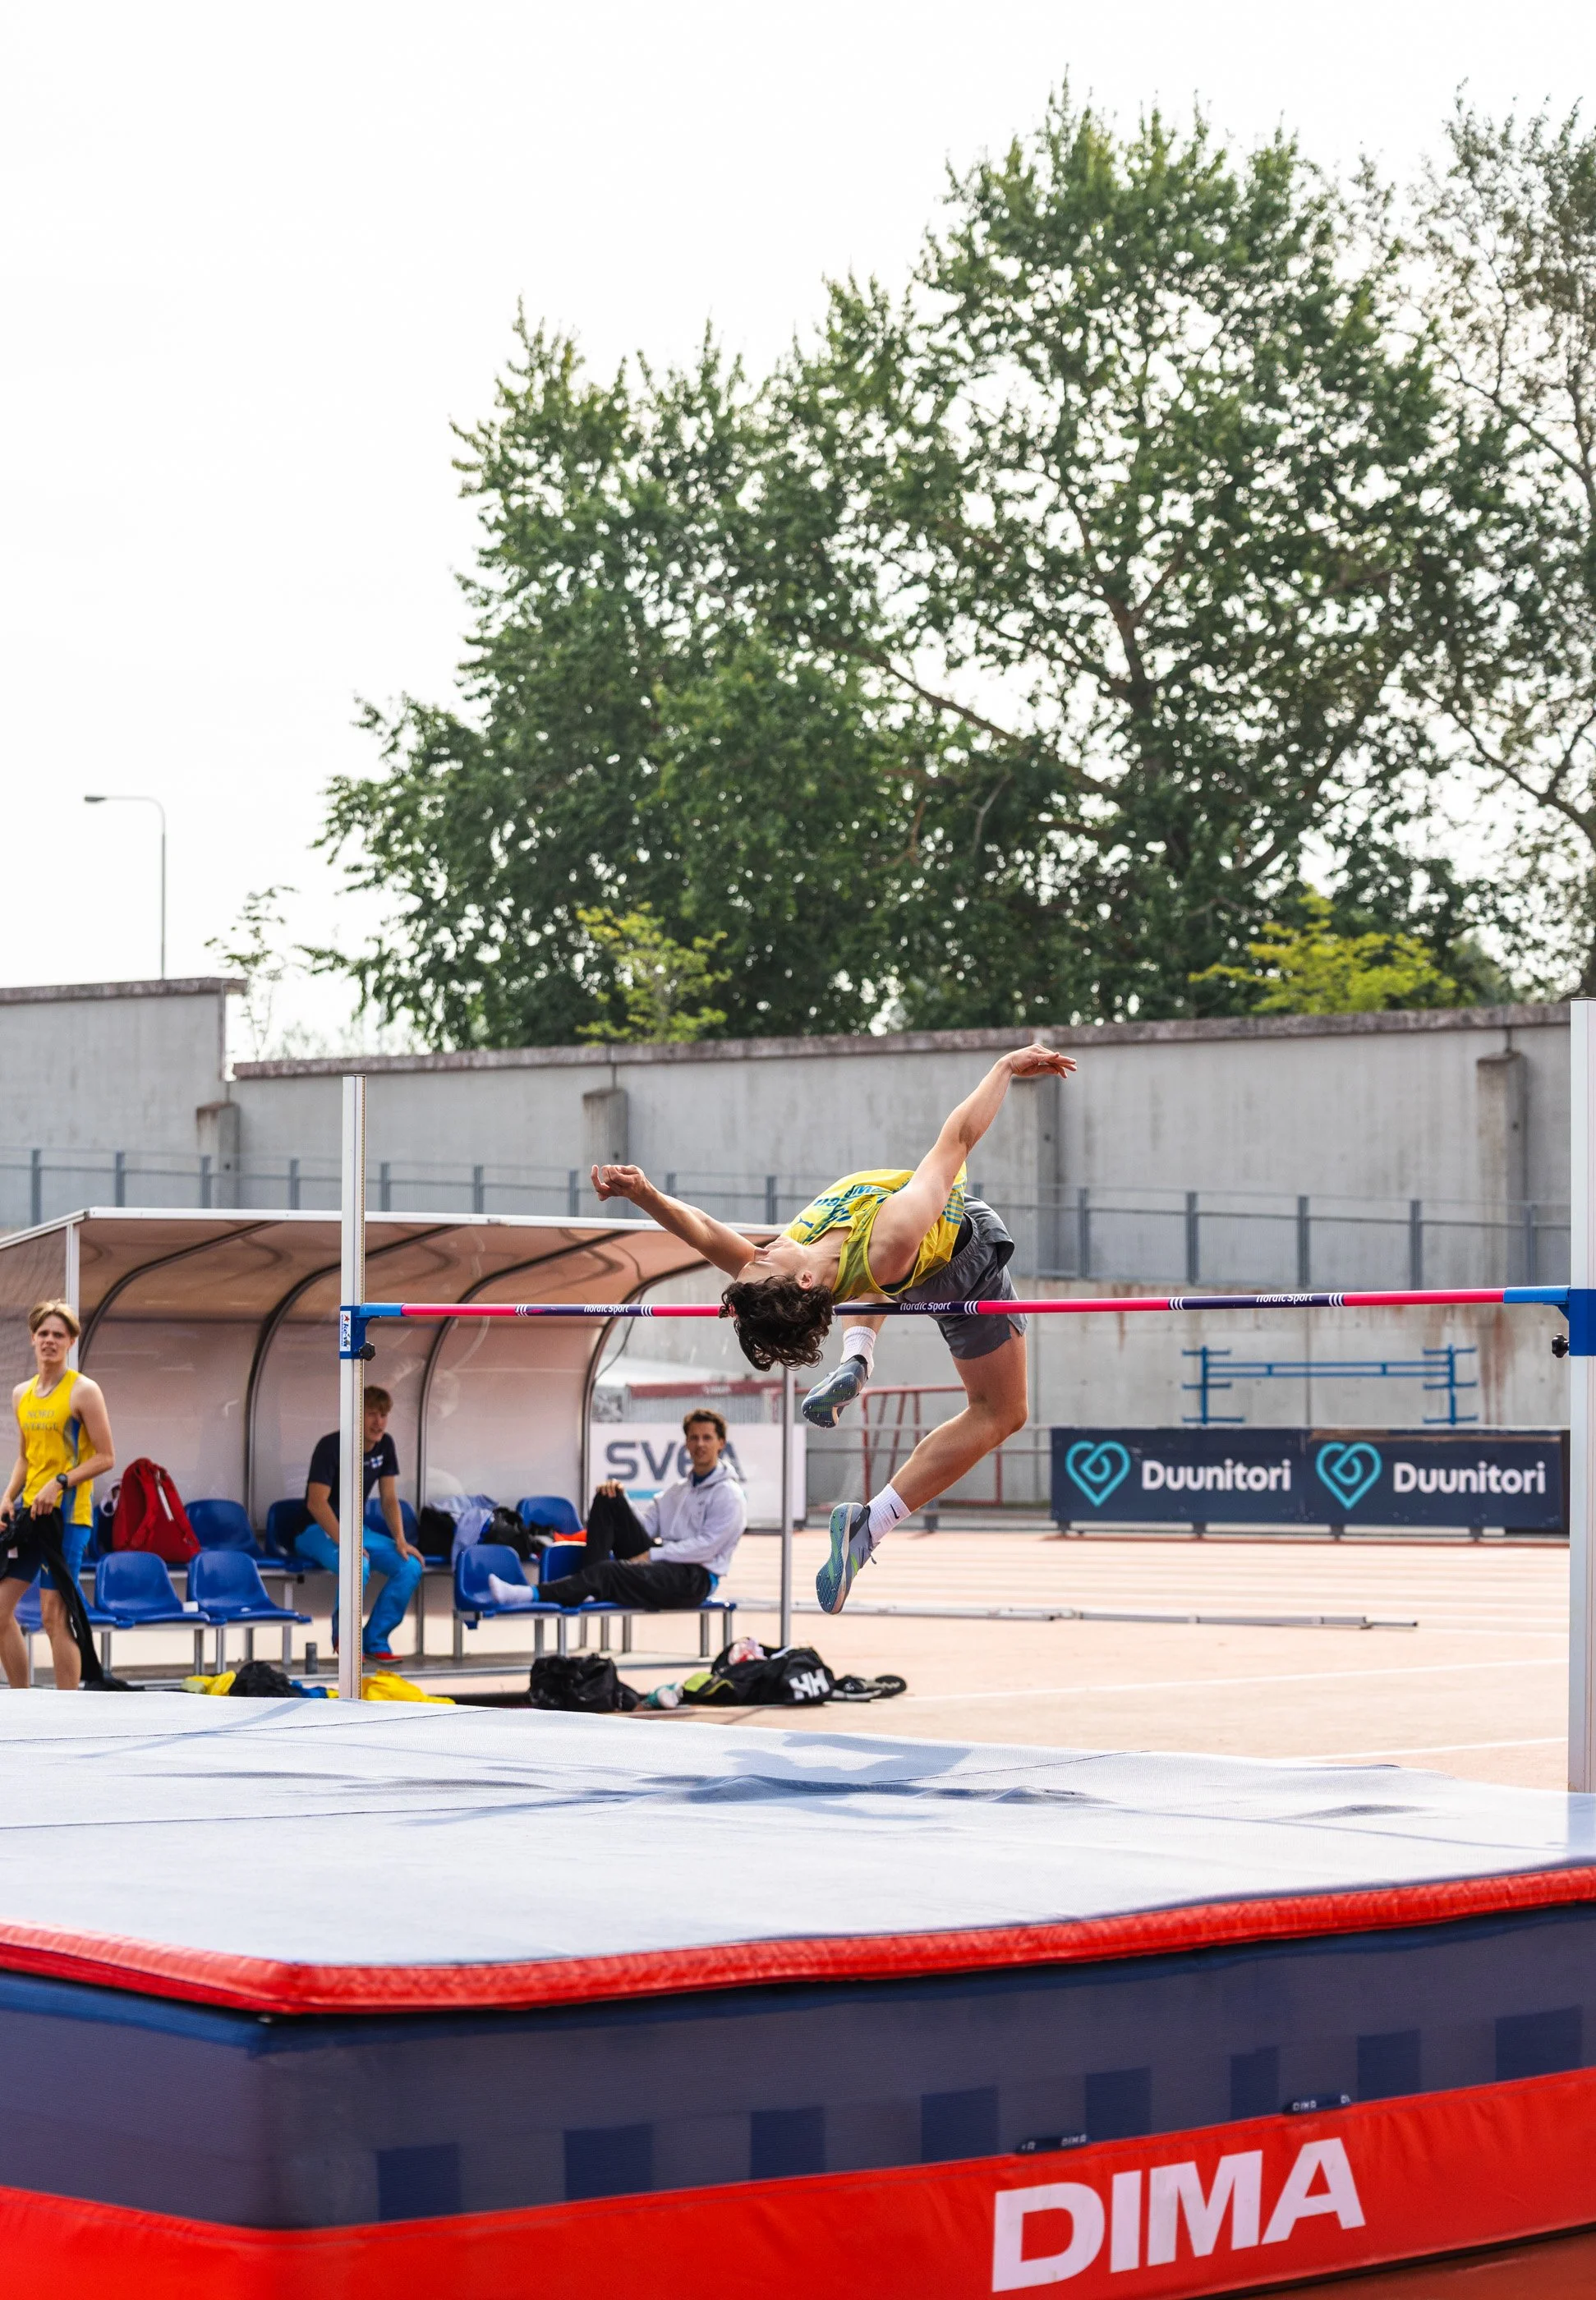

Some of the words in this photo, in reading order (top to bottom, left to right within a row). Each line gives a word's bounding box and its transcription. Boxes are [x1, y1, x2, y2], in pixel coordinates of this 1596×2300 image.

[927, 1301, 951, 1313] Sport
[1141, 1458, 1291, 1492] Duunitori
[1394, 1460, 1546, 1495] Duunitori
[991, 2137, 1366, 2293] DIMA
